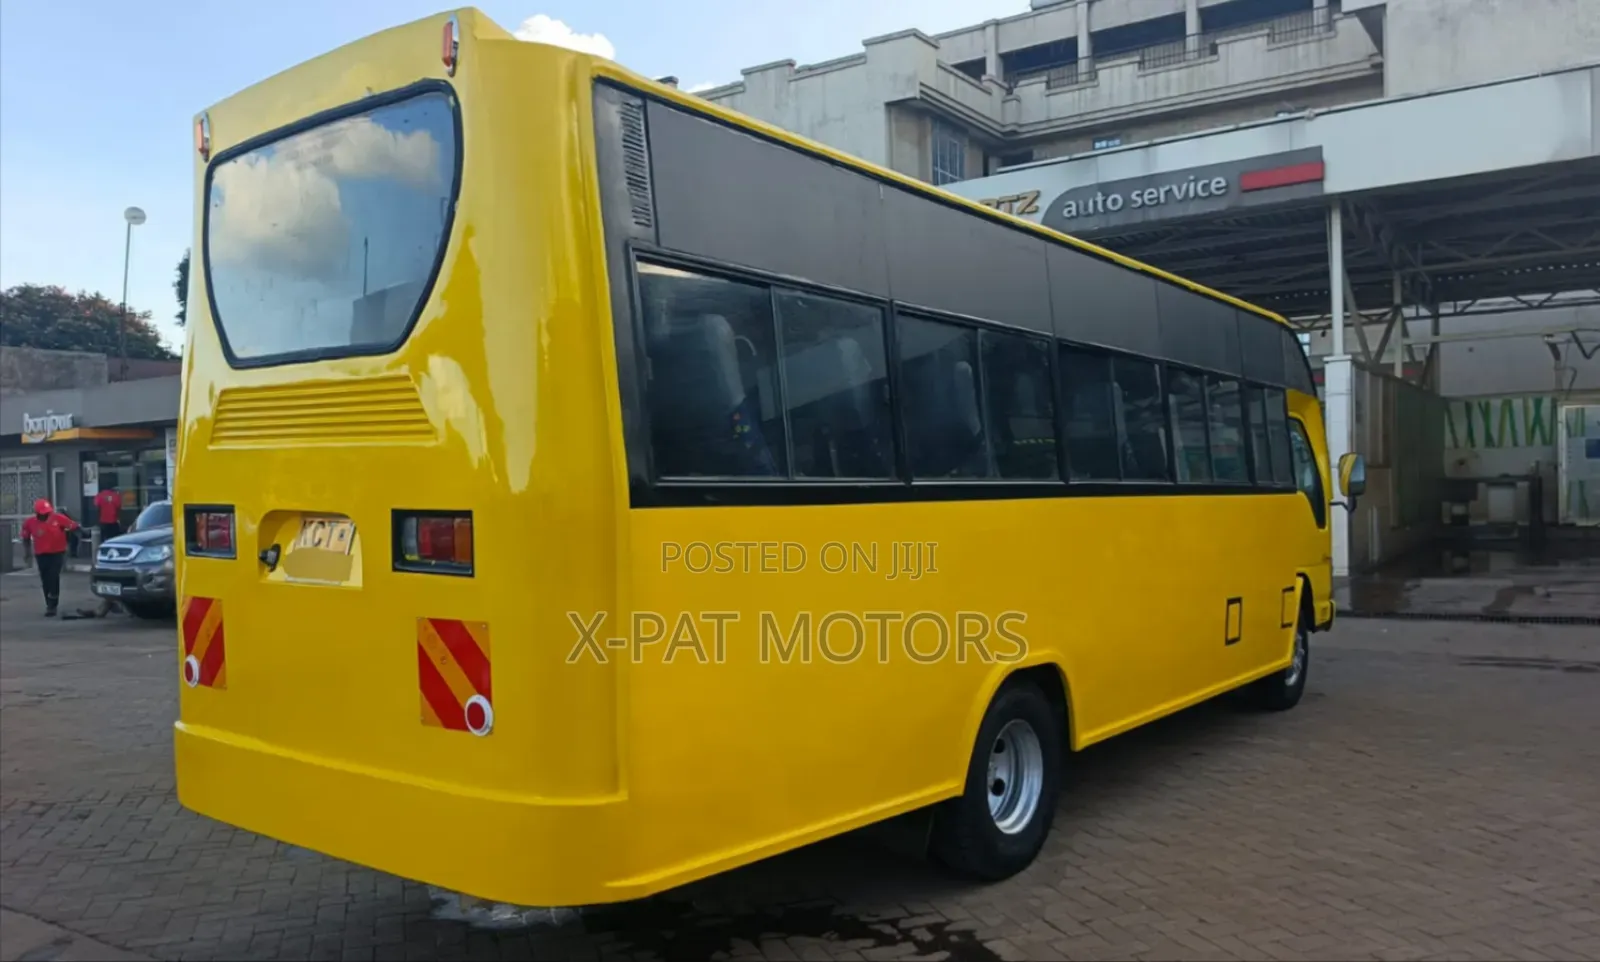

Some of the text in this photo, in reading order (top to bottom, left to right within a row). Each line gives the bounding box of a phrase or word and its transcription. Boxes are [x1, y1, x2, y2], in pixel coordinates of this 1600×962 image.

[1061, 175, 1227, 218] auto service
[23, 410, 73, 438] bonjour
